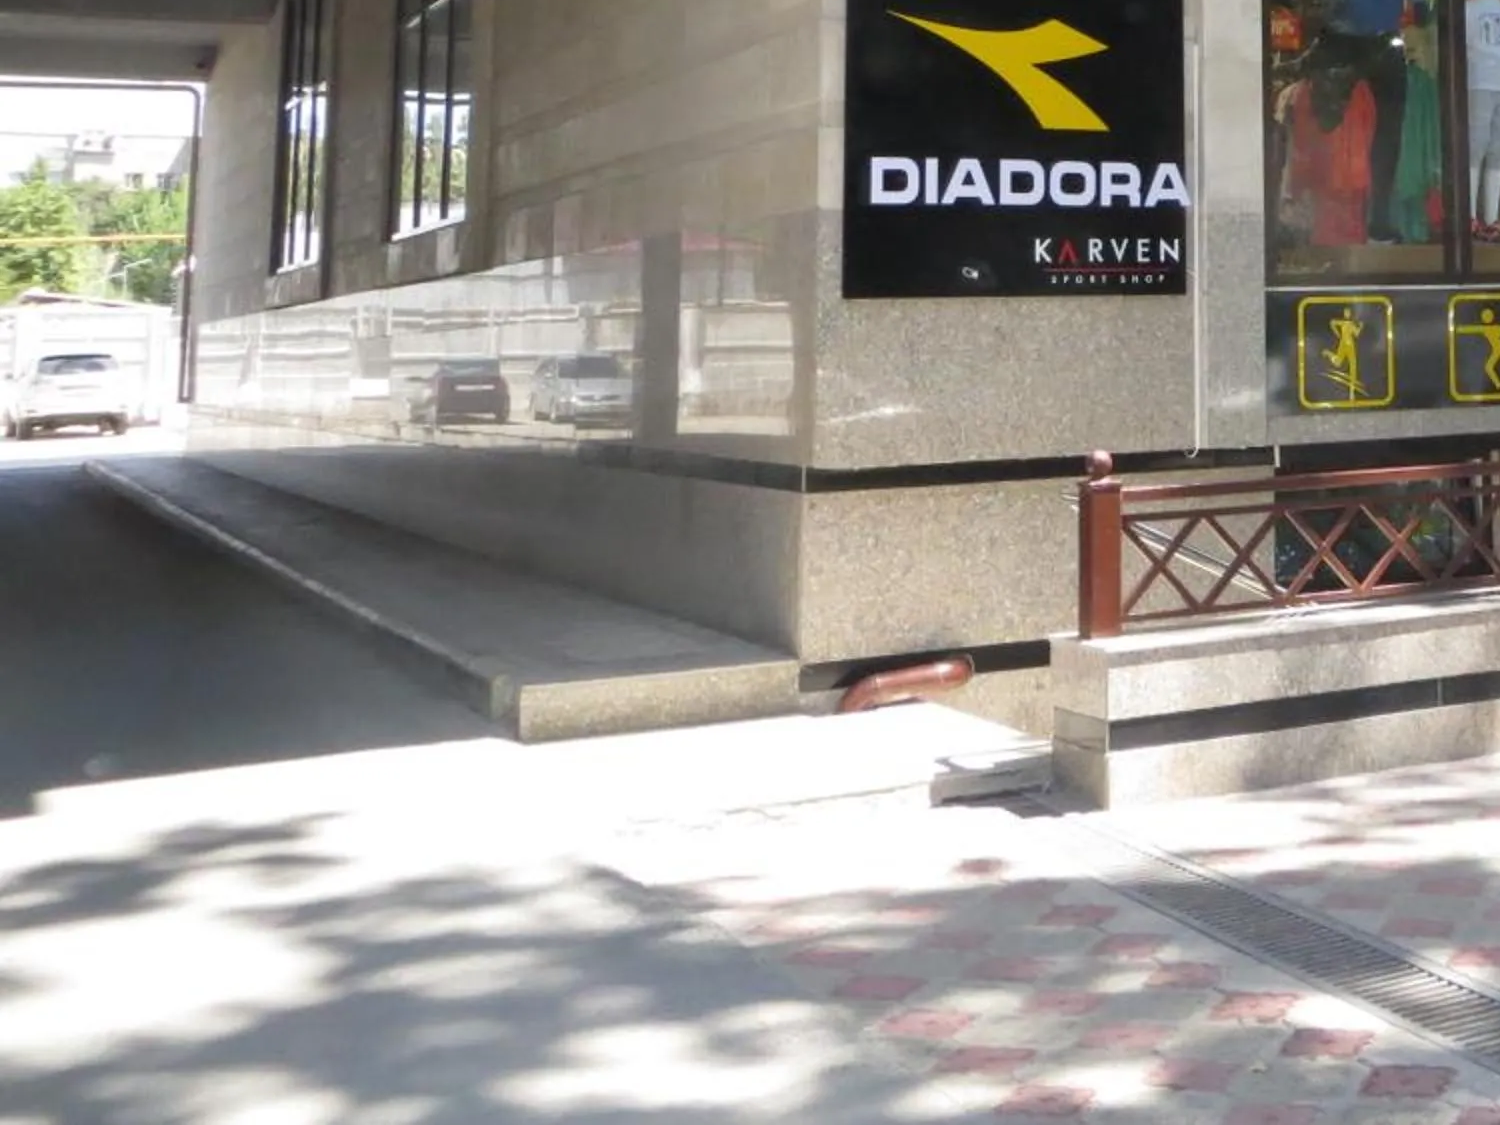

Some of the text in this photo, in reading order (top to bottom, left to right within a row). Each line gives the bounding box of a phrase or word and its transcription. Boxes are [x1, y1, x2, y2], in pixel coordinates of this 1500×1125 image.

[870, 156, 1191, 207] DIADORA
[1034, 238, 1180, 264] KARVEN
[1050, 274, 1165, 284] SPORT SHOP
